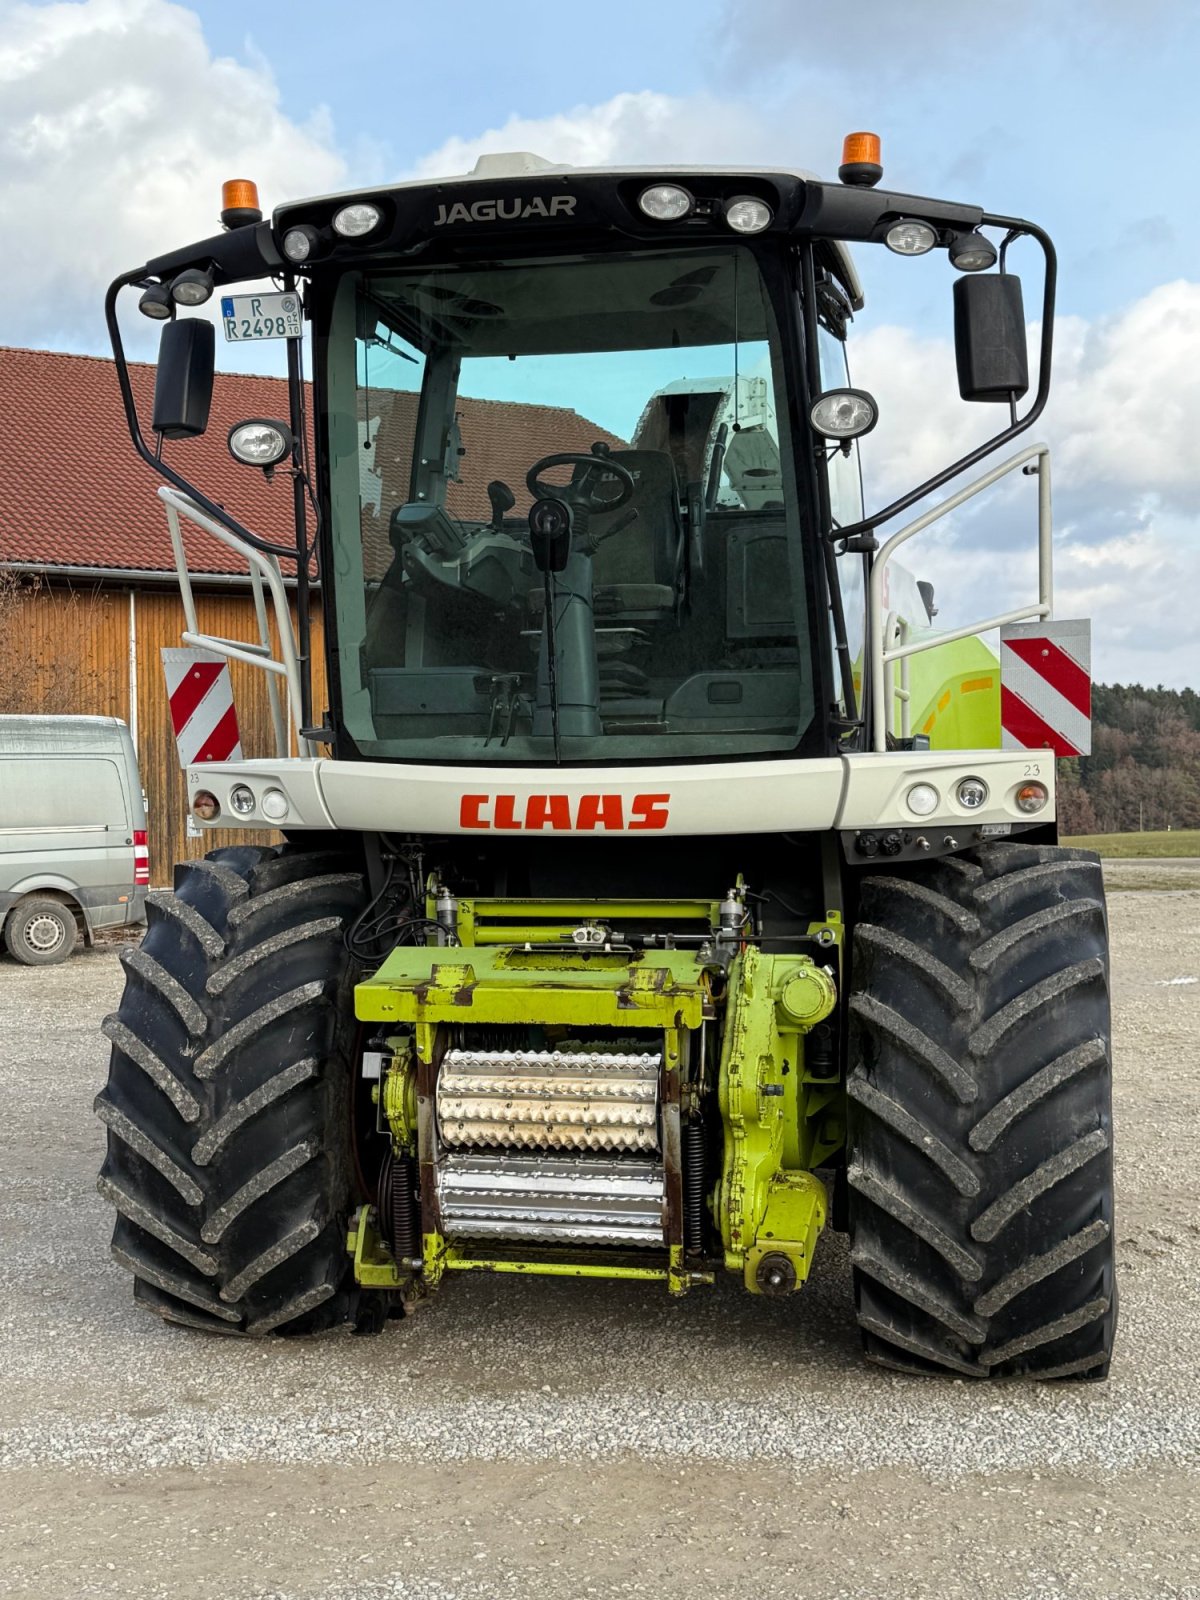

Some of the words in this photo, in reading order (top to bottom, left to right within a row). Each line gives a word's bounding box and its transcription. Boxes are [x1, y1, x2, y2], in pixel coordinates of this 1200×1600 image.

[434, 196, 577, 226] JAGUAR
[251, 298, 263, 317] R
[226, 320, 239, 339] R
[241, 317, 286, 338] 2498
[190, 773, 200, 784] 23
[1023, 764, 1040, 777] 23
[460, 793, 671, 830] CLAAS
